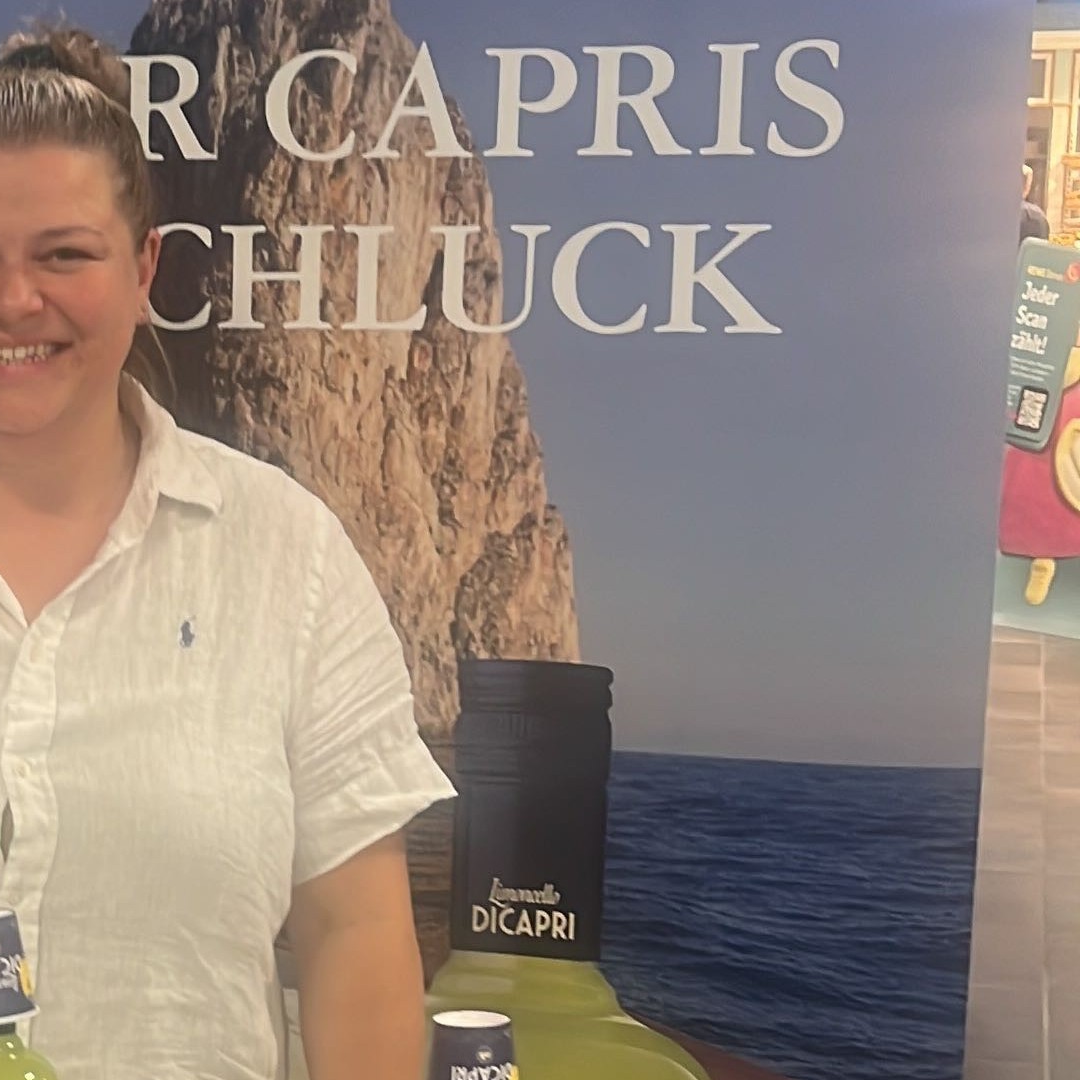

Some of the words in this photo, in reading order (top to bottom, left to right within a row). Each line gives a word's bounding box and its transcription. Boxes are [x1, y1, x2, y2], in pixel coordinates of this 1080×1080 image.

[264, 38, 845, 162] CAPRIS
[148, 220, 784, 335] CHLUCK
[1015, 304, 1049, 330] Scan
[472, 904, 576, 940] DICAPRI
